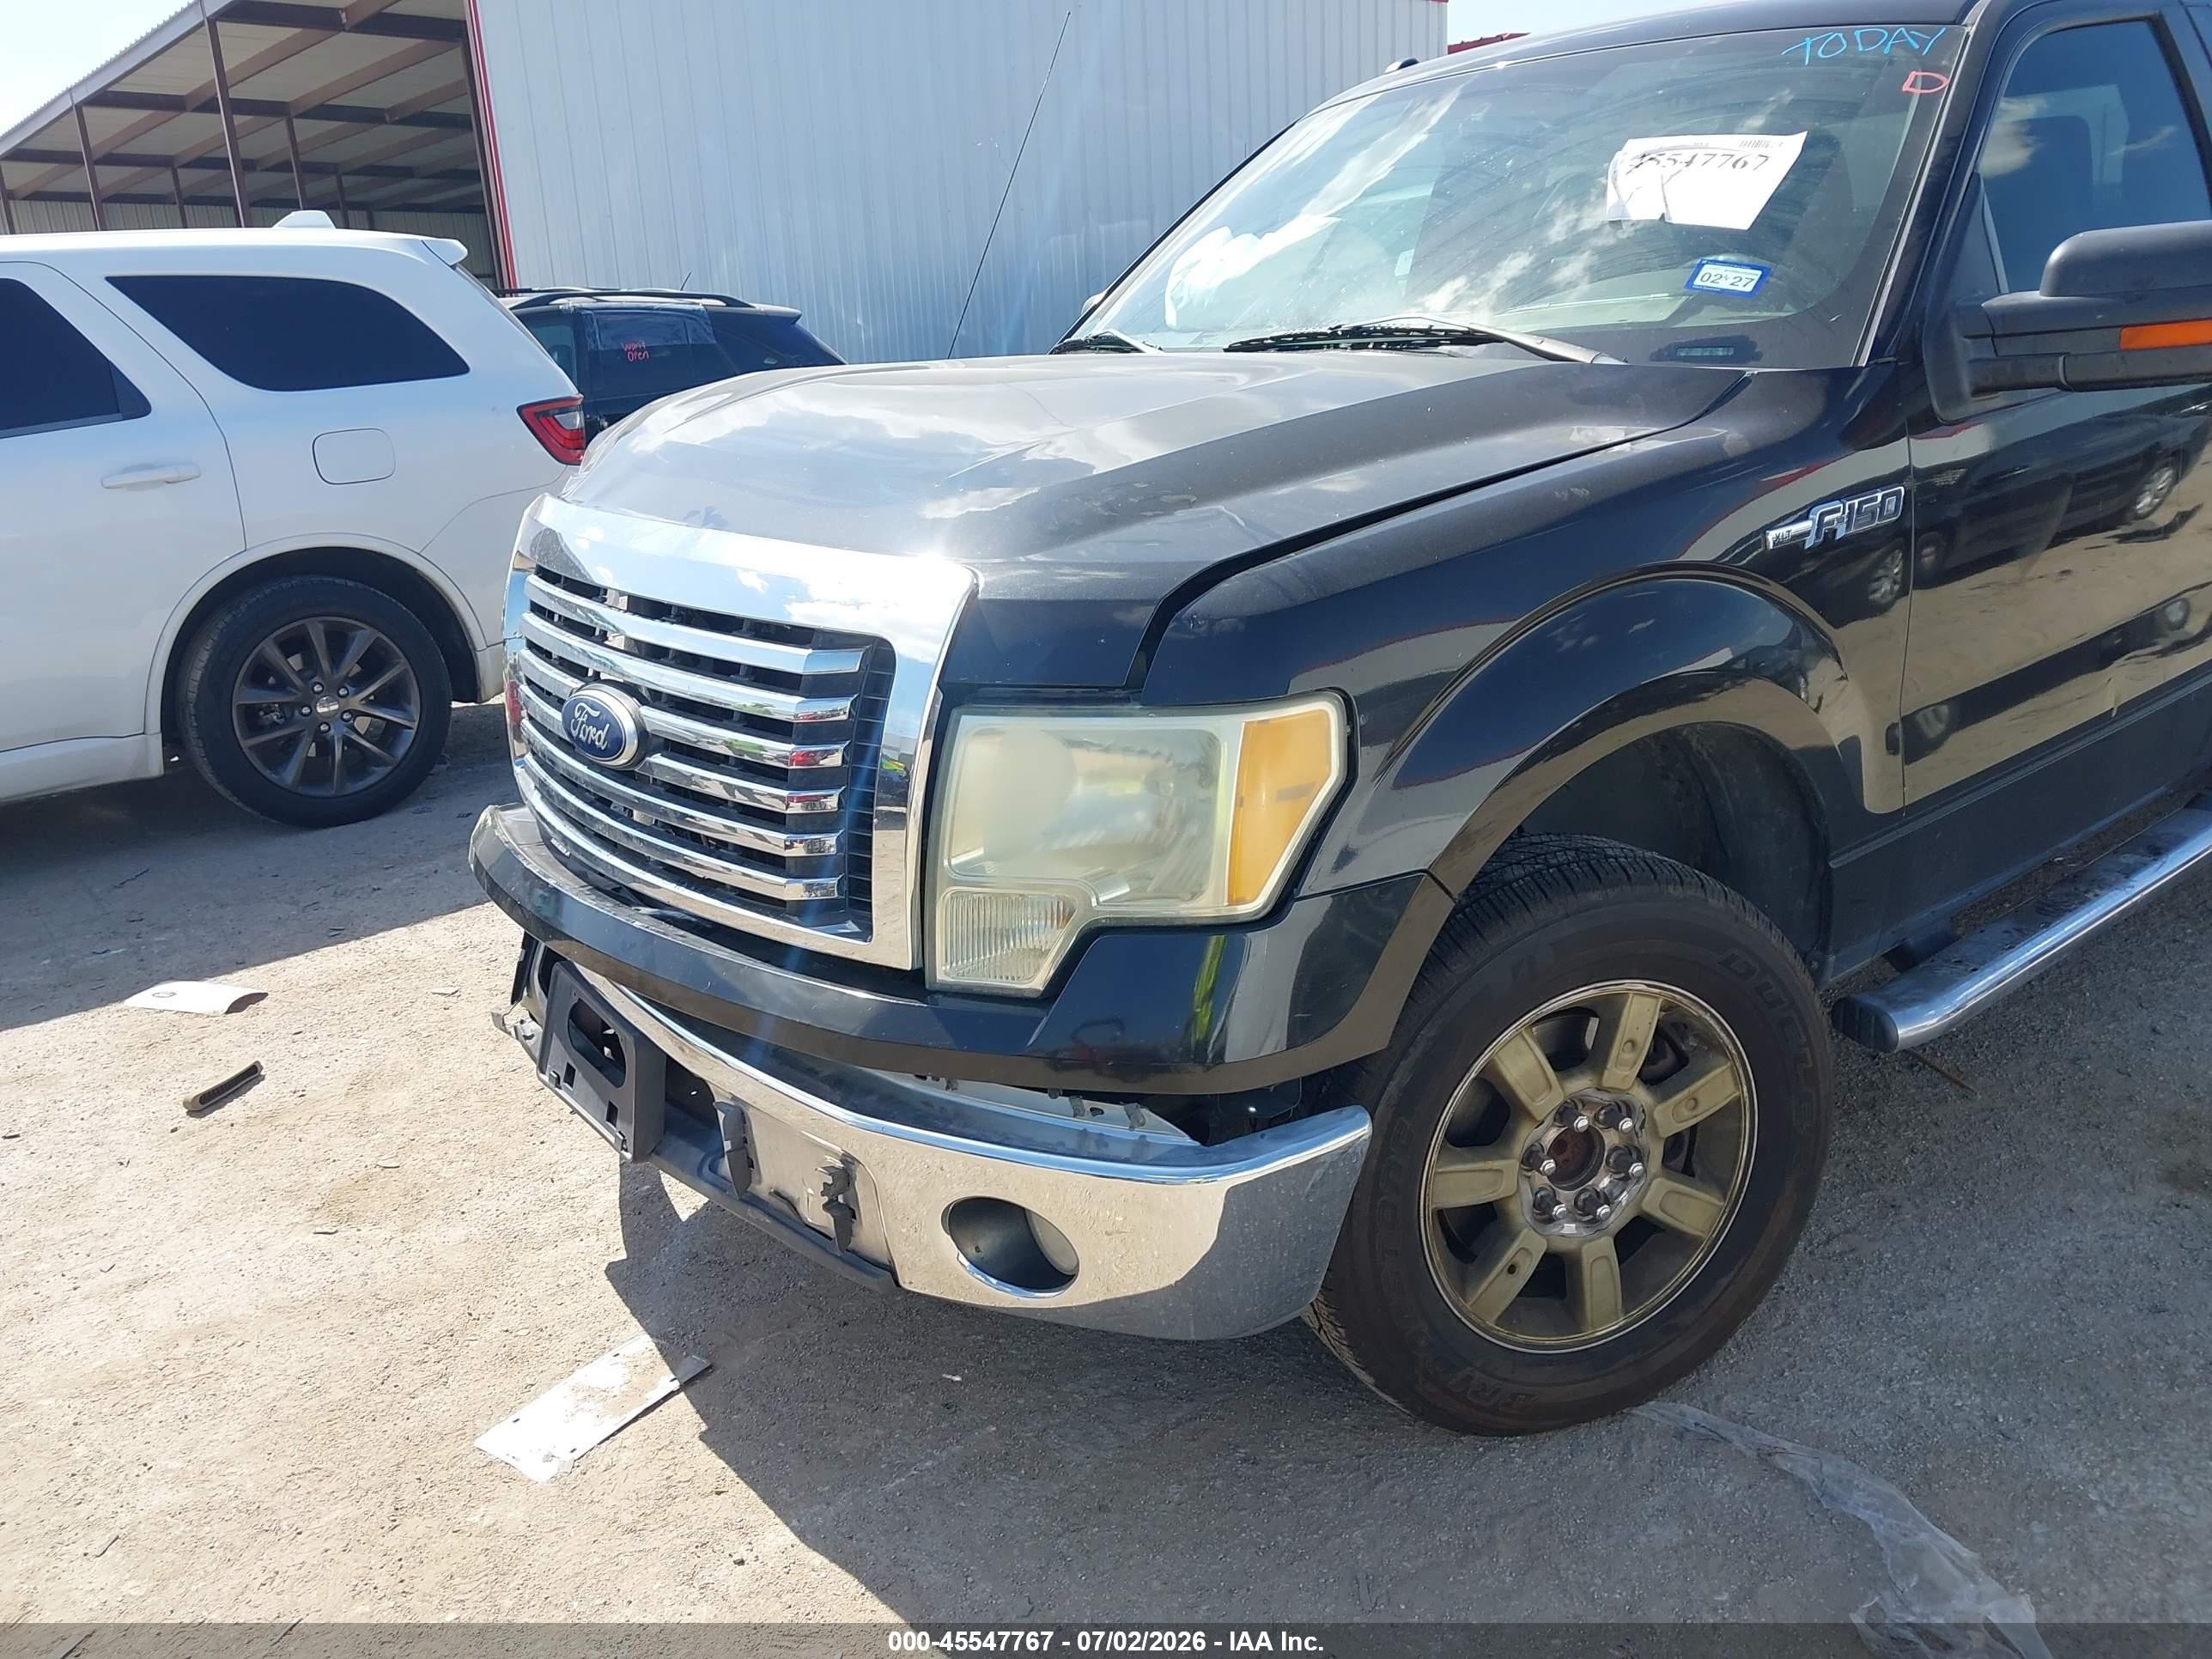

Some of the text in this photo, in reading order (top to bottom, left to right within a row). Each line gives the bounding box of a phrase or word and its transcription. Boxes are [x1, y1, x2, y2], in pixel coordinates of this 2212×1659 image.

[1781, 27, 1947, 66] TODAY
[1700, 271, 1723, 284] 02
[1729, 275, 1756, 288] 27
[570, 702, 611, 750] Ford
